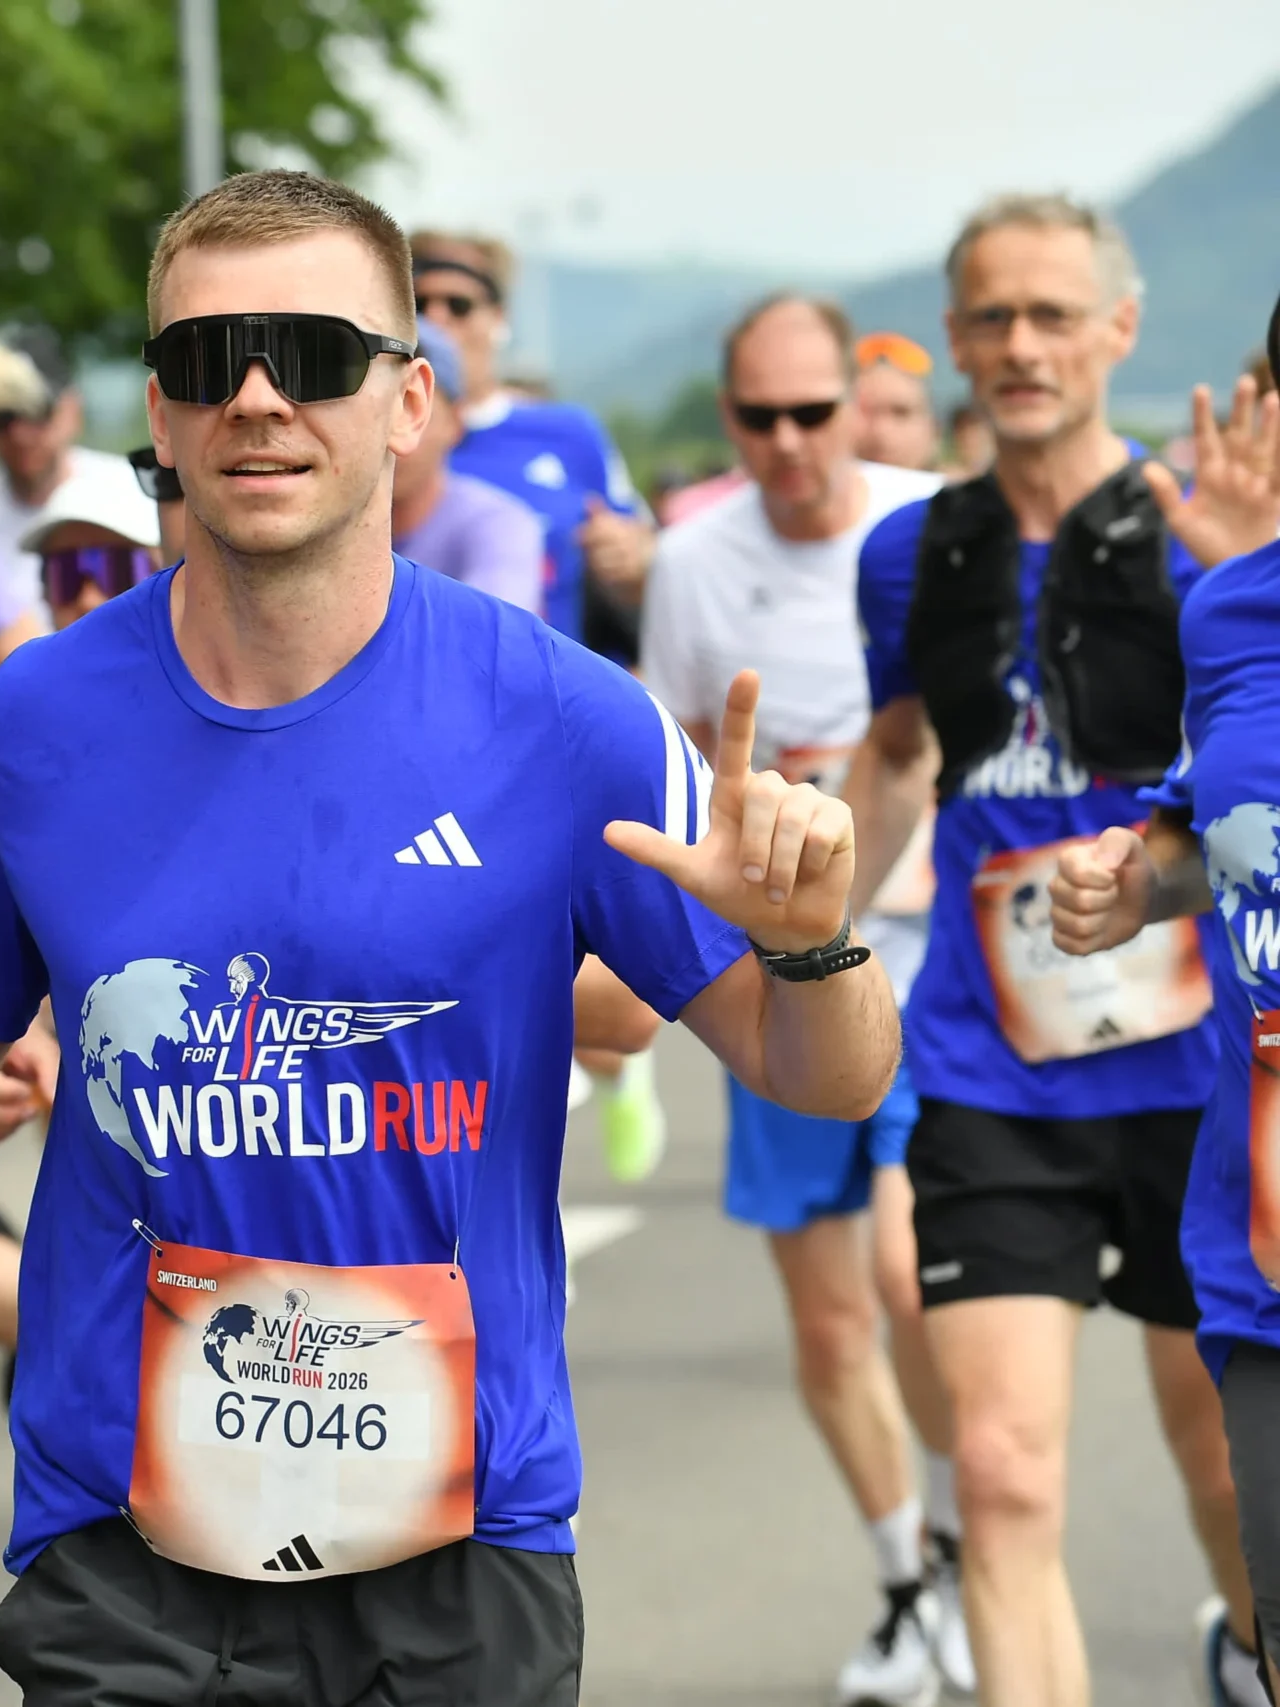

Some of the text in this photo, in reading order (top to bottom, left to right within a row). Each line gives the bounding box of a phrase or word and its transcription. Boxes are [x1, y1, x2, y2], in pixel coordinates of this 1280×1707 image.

[181, 1045, 310, 1081] FOR LIFE
[157, 1270, 217, 1292] SWITZERLAND
[256, 1338, 330, 1367] FOR LIFE
[327, 1372, 368, 1390] 2026
[215, 1391, 388, 1451] 67046
